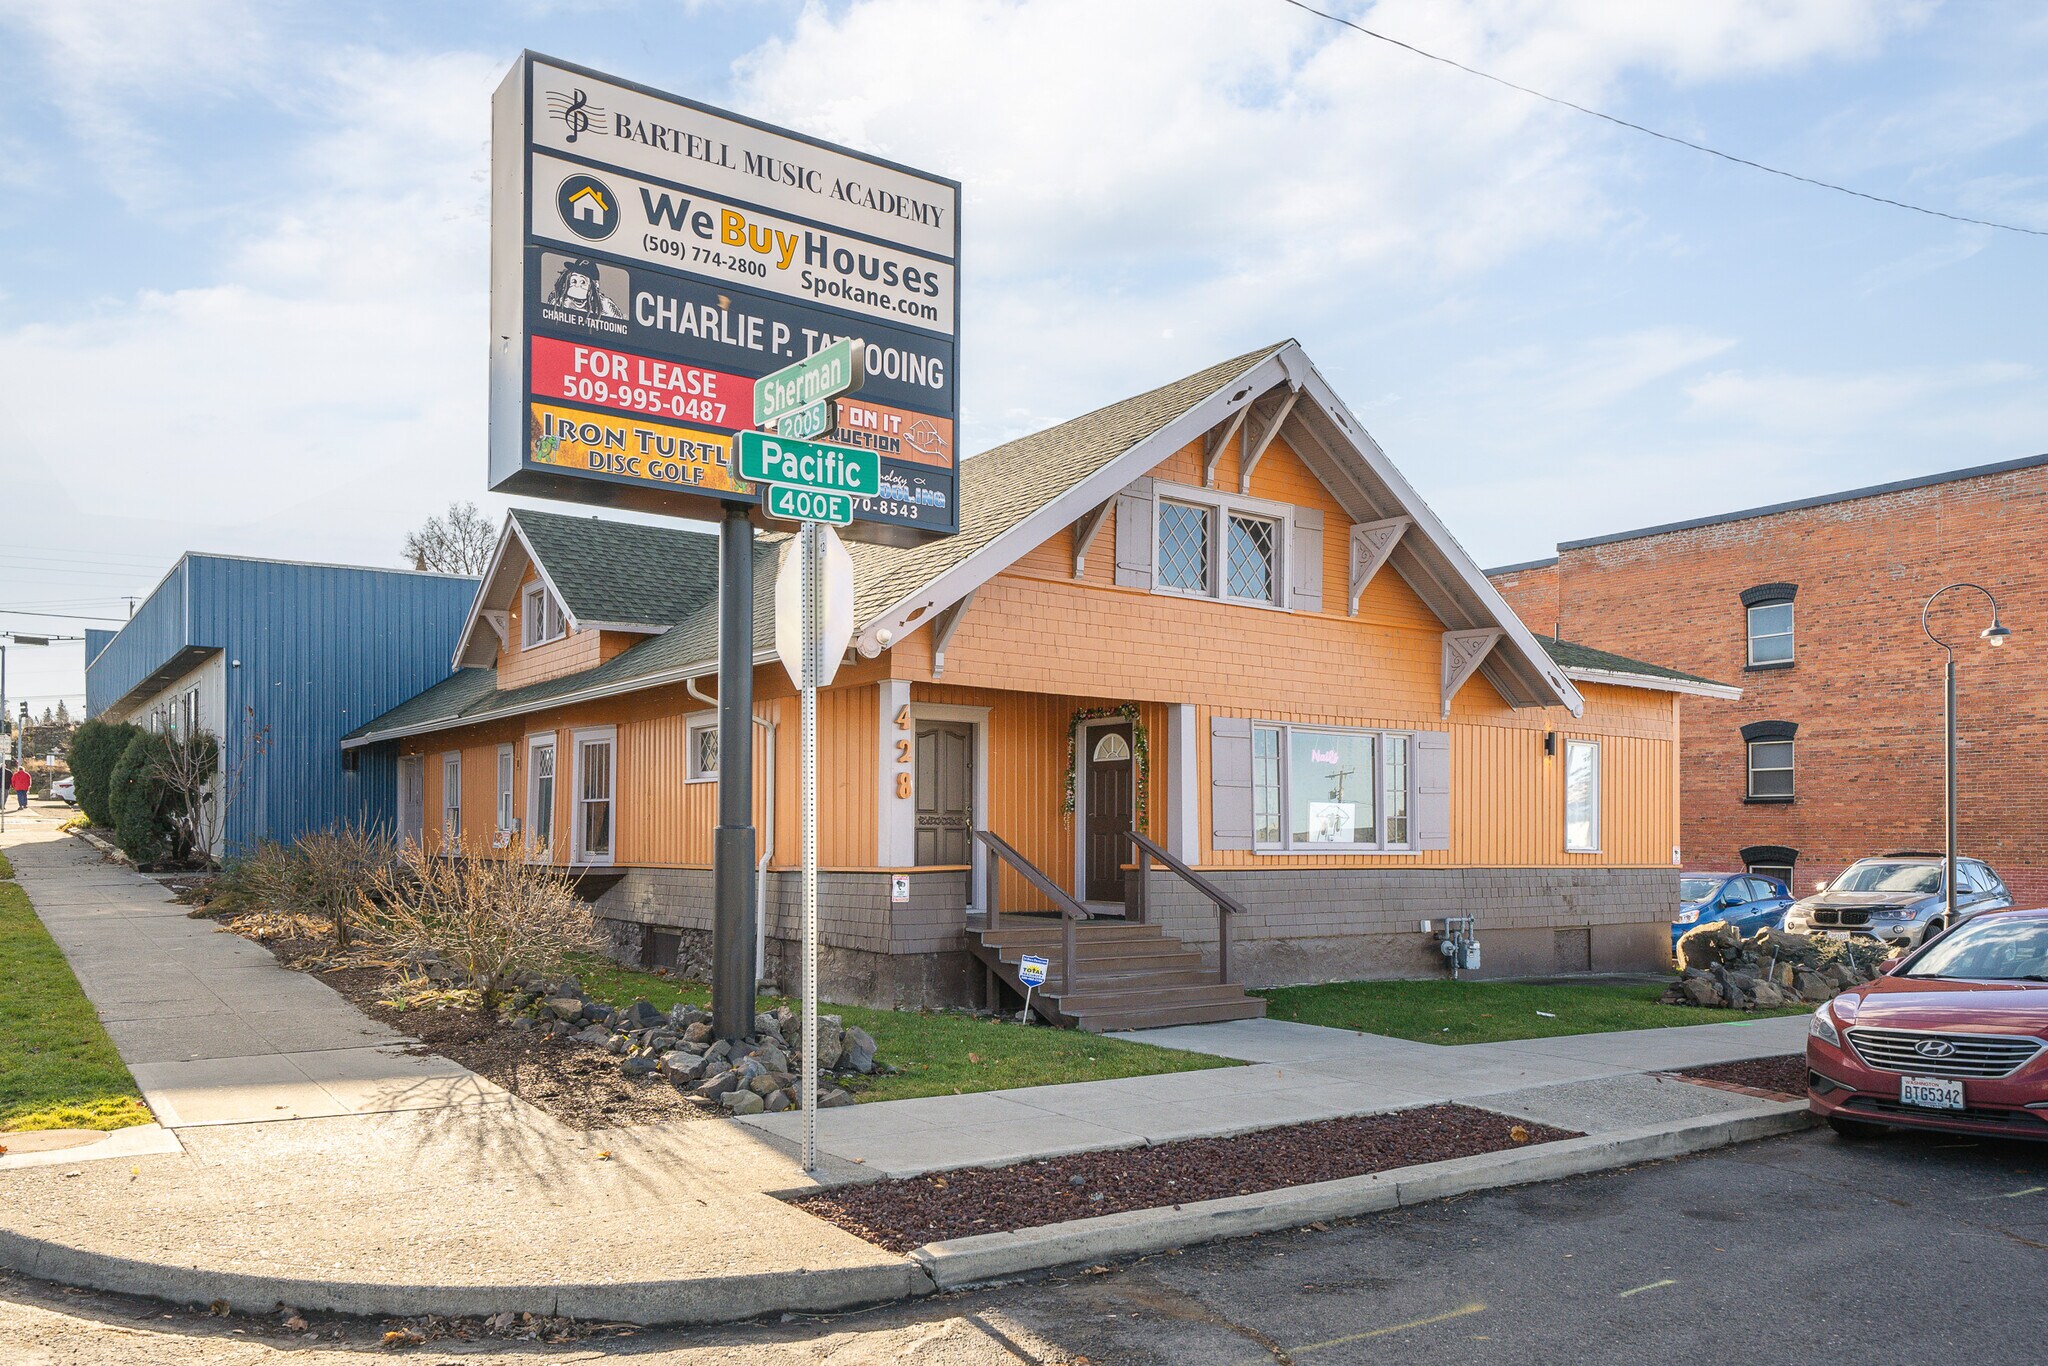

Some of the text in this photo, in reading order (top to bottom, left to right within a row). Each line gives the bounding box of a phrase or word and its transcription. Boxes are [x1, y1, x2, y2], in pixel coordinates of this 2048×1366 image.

[613, 111, 946, 229] BARTELL MUSIC ACADEMY
[642, 234, 767, 279] (509) 774-2800
[801, 270, 939, 322] Spokane.com
[542, 308, 628, 335] CHARLIE P. TATTOOING
[635, 291, 944, 389] CHARLIE P. TAOOING
[574, 346, 717, 398] FOR LEASE
[763, 357, 841, 416] Sherman
[563, 375, 727, 424] 509-995-0487
[784, 406, 820, 438] 200S
[849, 406, 878, 430] ON
[883, 413, 902, 434] IT
[543, 412, 734, 468] IRON TURTL
[824, 427, 901, 454] RUCTION
[588, 450, 705, 485] DISC GOLF
[762, 440, 861, 487] Pacific
[779, 491, 843, 520] 400E
[853, 497, 918, 519] 70-8543
[879, 482, 946, 509] OOLING
[1022, 967, 1044, 975] TOTAL
[1905, 1085, 1960, 1104] BTG5342
